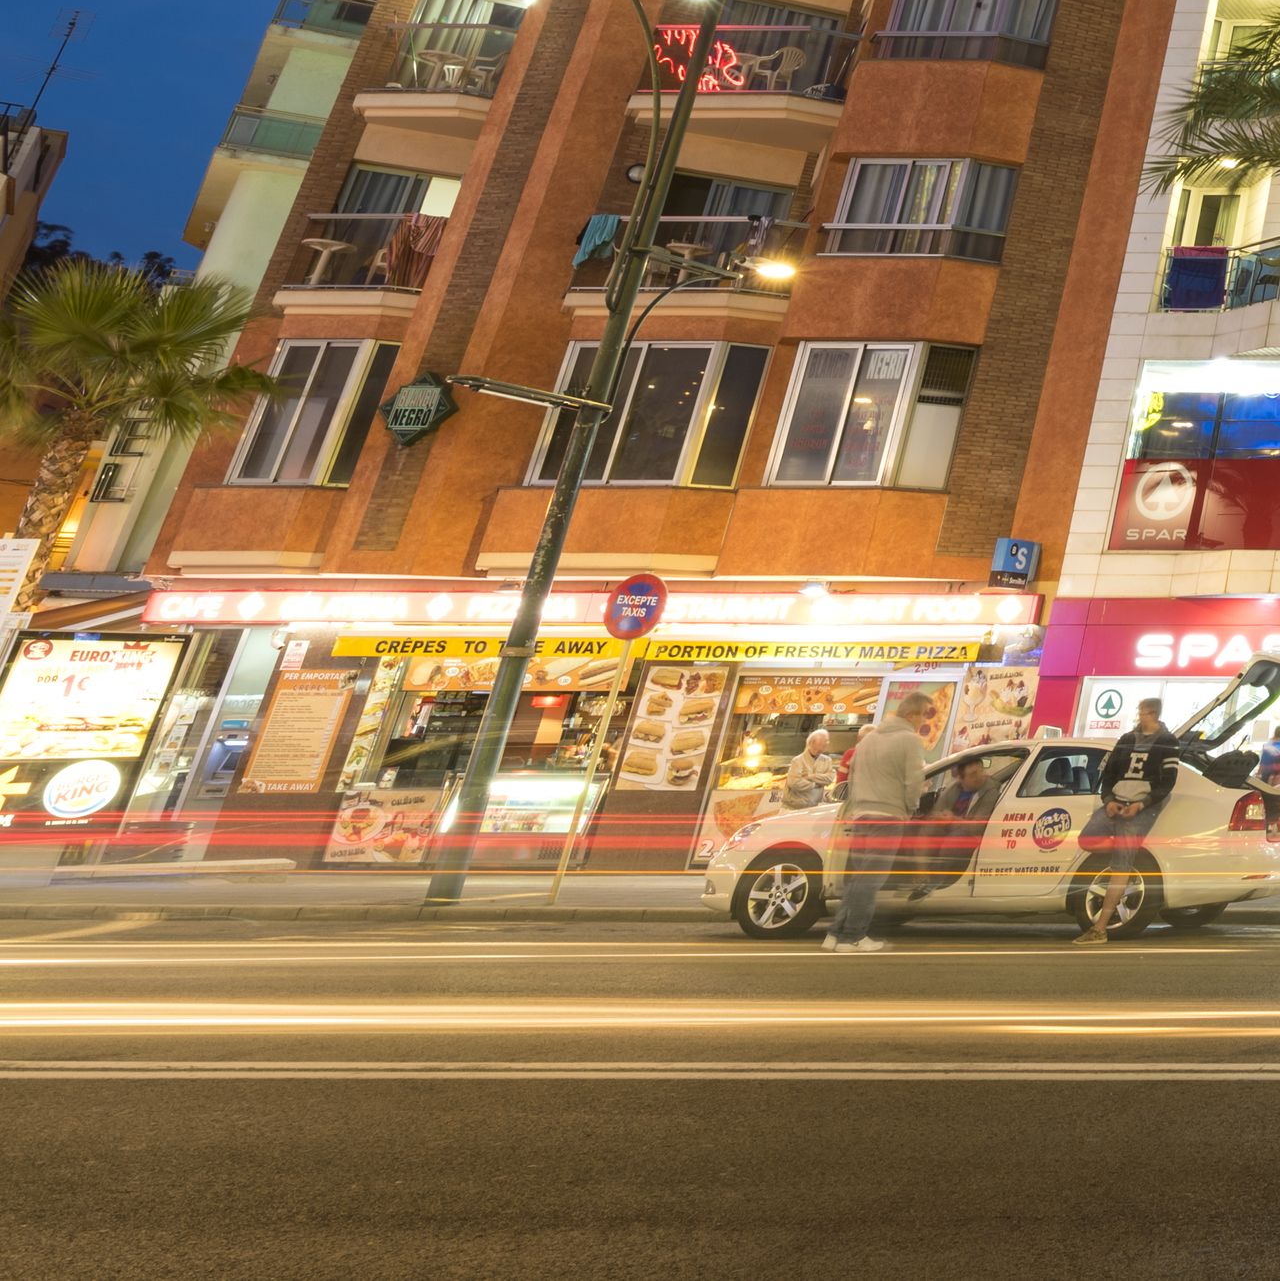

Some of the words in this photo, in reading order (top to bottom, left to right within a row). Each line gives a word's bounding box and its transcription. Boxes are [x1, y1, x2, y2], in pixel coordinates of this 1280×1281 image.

[391, 408, 432, 427] NEGRO
[1125, 528, 1187, 542] SPAR
[1015, 547, 1028, 570] S
[616, 594, 659, 606] EXCEPTE
[621, 606, 647, 617] TAXIS
[374, 636, 447, 655] CRÊPES
[463, 640, 488, 654] TO
[498, 640, 544, 654] TE
[554, 640, 608, 655] AWAY
[655, 643, 741, 660] PORTION
[744, 643, 770, 660] OF
[774, 642, 854, 660] FRESHLY
[858, 643, 912, 661] MADE
[915, 644, 969, 661] PIZZA
[283, 672, 299, 681] PER
[773, 677, 802, 685] TAKE
[805, 677, 838, 685] AWAY
[1089, 721, 1121, 730] SPAR
[1124, 752, 1150, 779] E
[266, 783, 289, 791] TAKE
[289, 782, 316, 791] AWAY
[1027, 812, 1034, 821] A
[1001, 828, 1013, 838] WE
[1015, 828, 1027, 838] GO
[1006, 839, 1017, 850] TO
